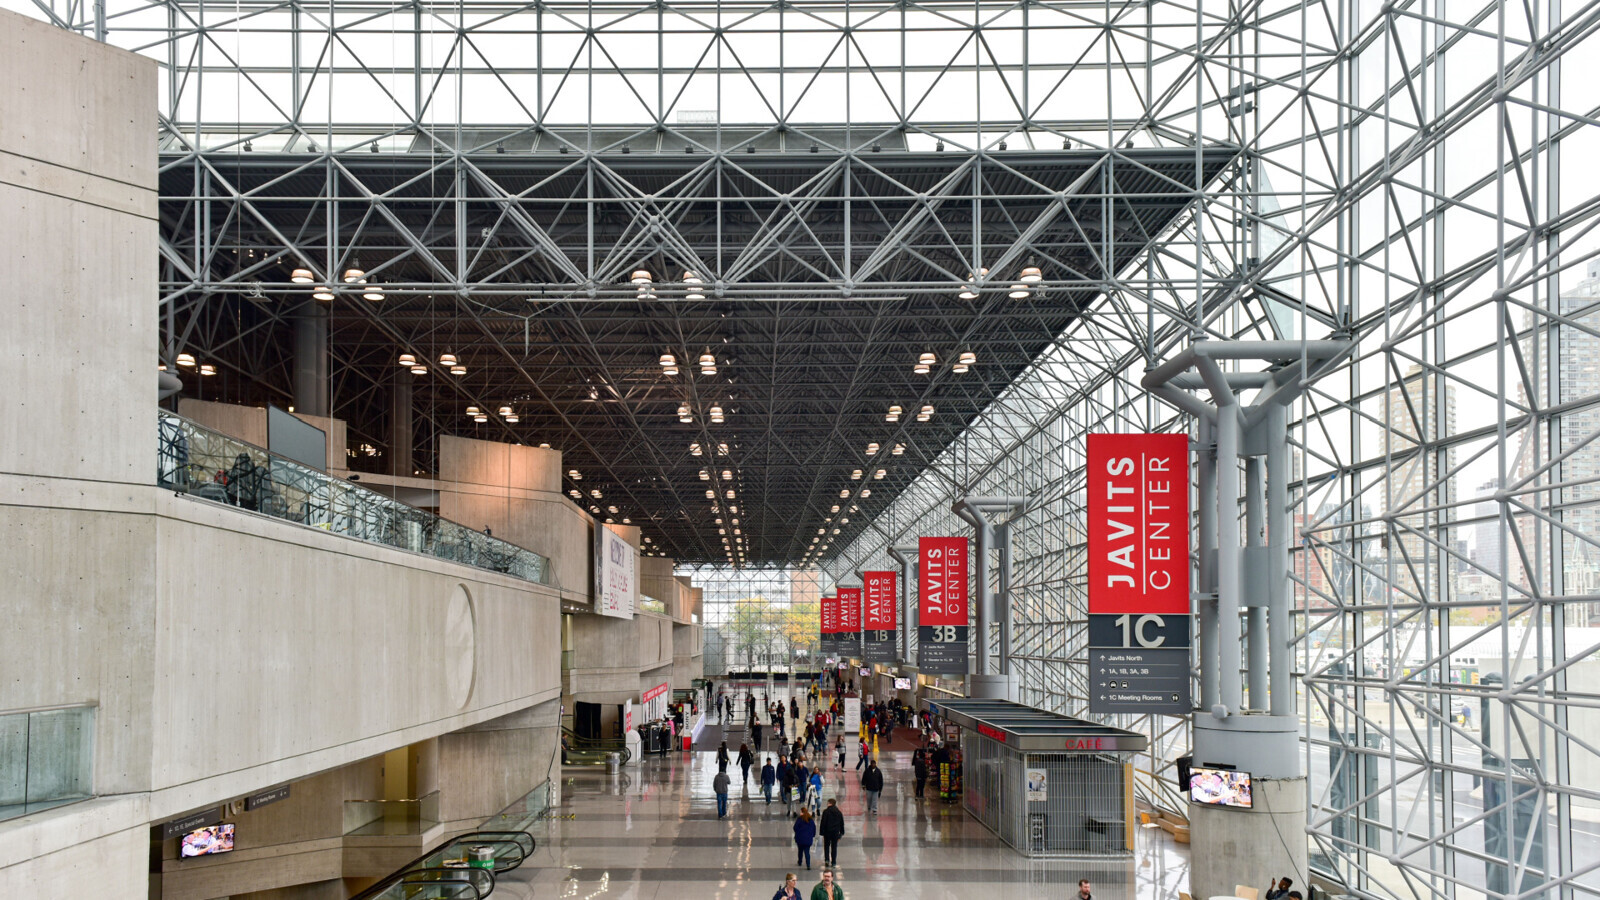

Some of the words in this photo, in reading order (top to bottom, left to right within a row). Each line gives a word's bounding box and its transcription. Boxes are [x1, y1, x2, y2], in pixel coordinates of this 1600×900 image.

[1107, 457, 1135, 588] JAVITS
[1149, 457, 1171, 590] CENTER
[927, 548, 942, 613] JAVITS
[948, 548, 960, 614] CENTER
[840, 593, 849, 626] JAVITS
[850, 593, 858, 627] CENTER
[869, 579, 880, 622] JAVITS
[883, 578, 891, 623] CENTER
[842, 632, 856, 641] 3A
[873, 630, 889, 641] 1B
[932, 625, 957, 643] 3B
[1115, 614, 1166, 648] 1C
[1065, 737, 1103, 750] CAFÉ
